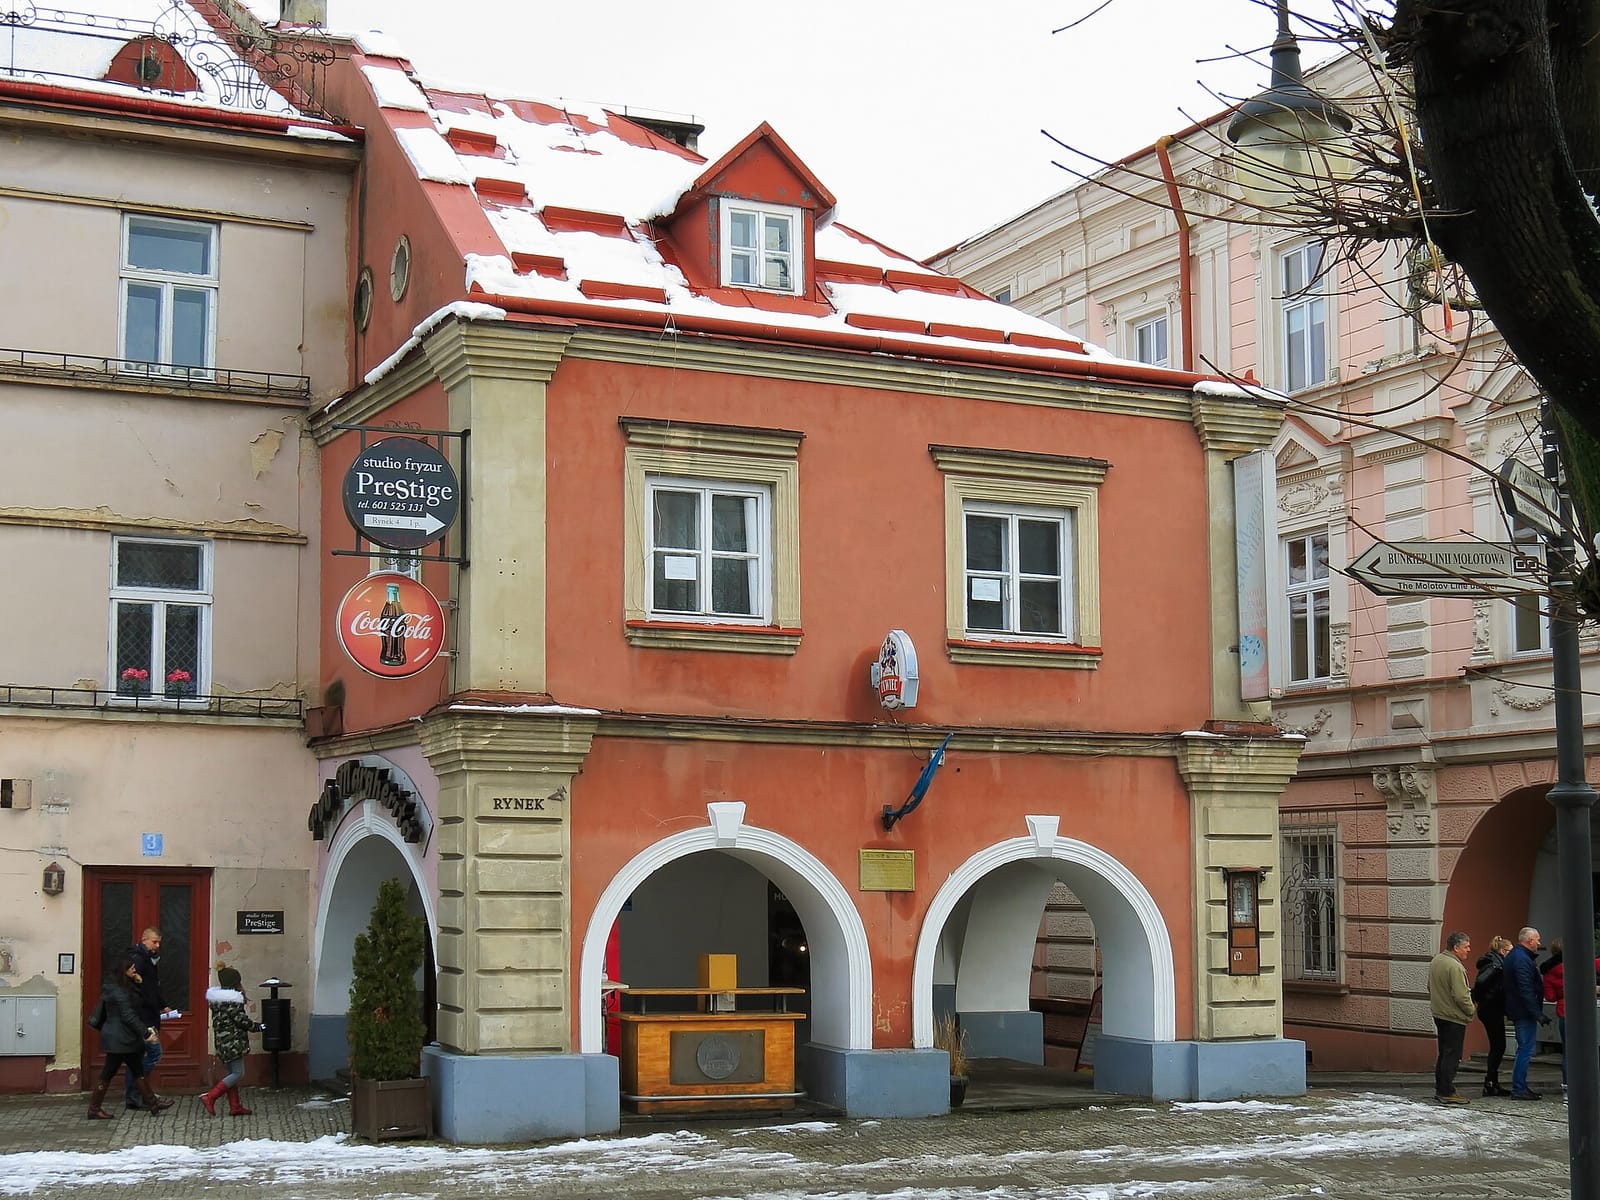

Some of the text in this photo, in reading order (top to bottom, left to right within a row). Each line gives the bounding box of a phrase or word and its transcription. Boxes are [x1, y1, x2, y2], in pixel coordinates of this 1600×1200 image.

[363, 456, 443, 475] studio fryzur
[357, 500, 424, 512] tel. 601 525 131
[1388, 552, 1427, 565] BUNKIER
[1430, 552, 1451, 565] LINII
[1415, 581, 1448, 589] Molotov
[493, 797, 545, 810] RYNEK
[146, 834, 156, 849] 3
